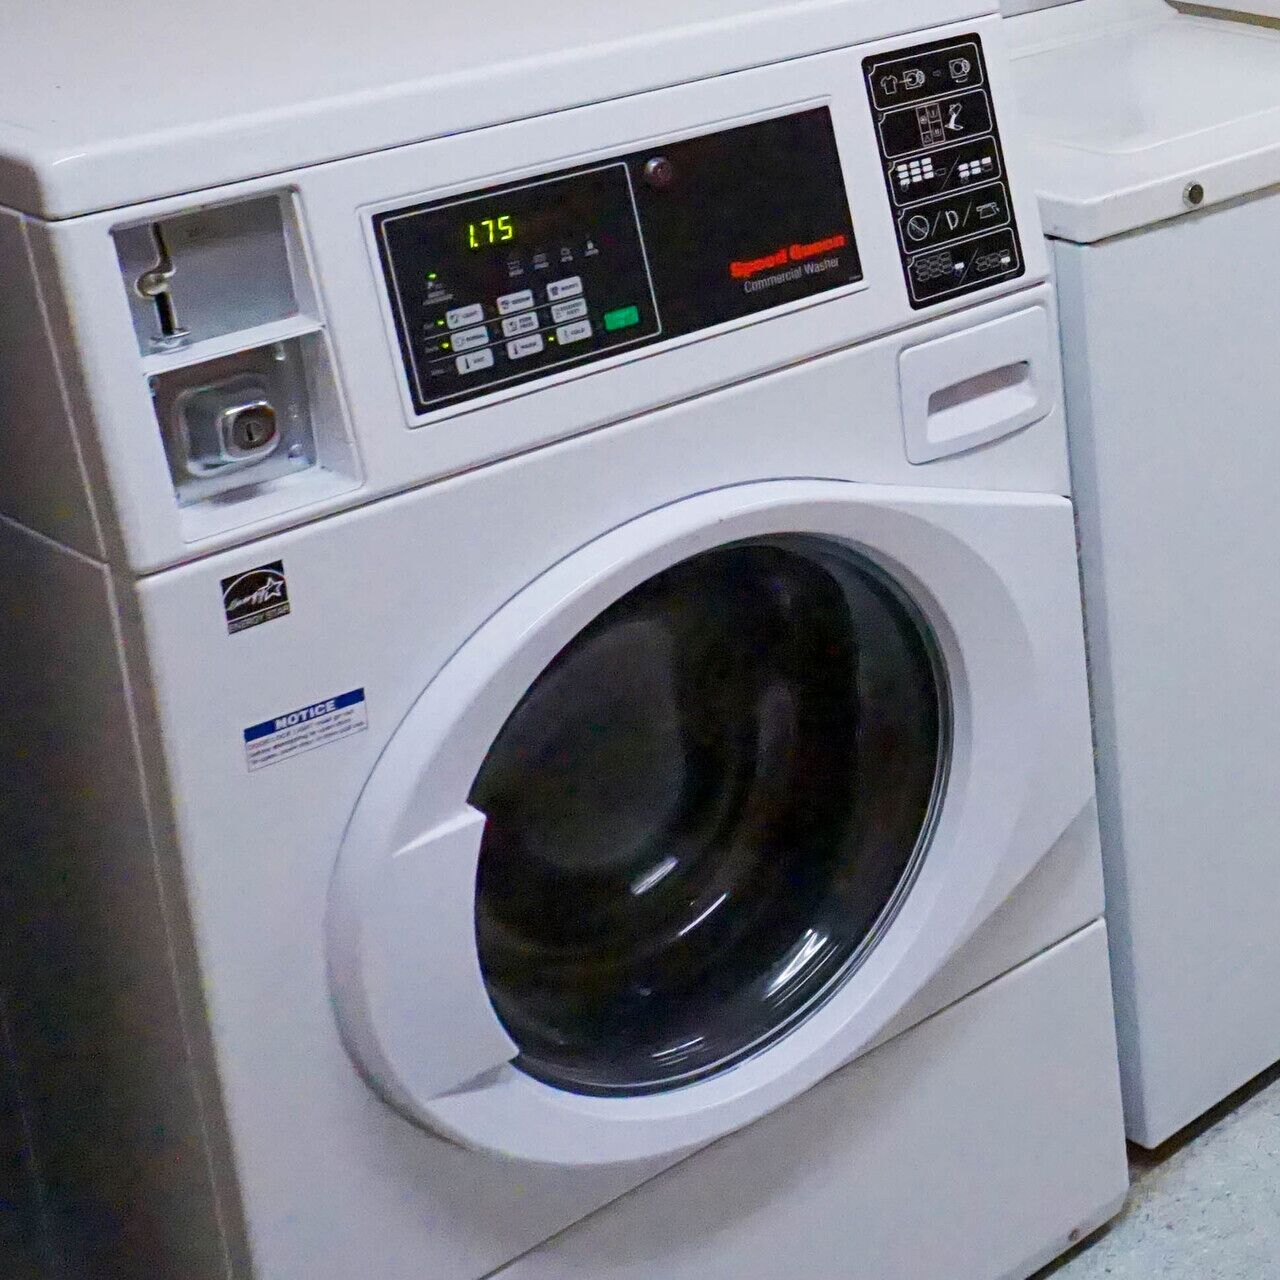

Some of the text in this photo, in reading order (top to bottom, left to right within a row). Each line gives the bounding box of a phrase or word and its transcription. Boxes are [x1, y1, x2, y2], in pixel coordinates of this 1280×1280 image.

[469, 215, 514, 249] 1.75
[743, 256, 840, 294] Commercial Washer
[275, 699, 337, 730] NOTICE
